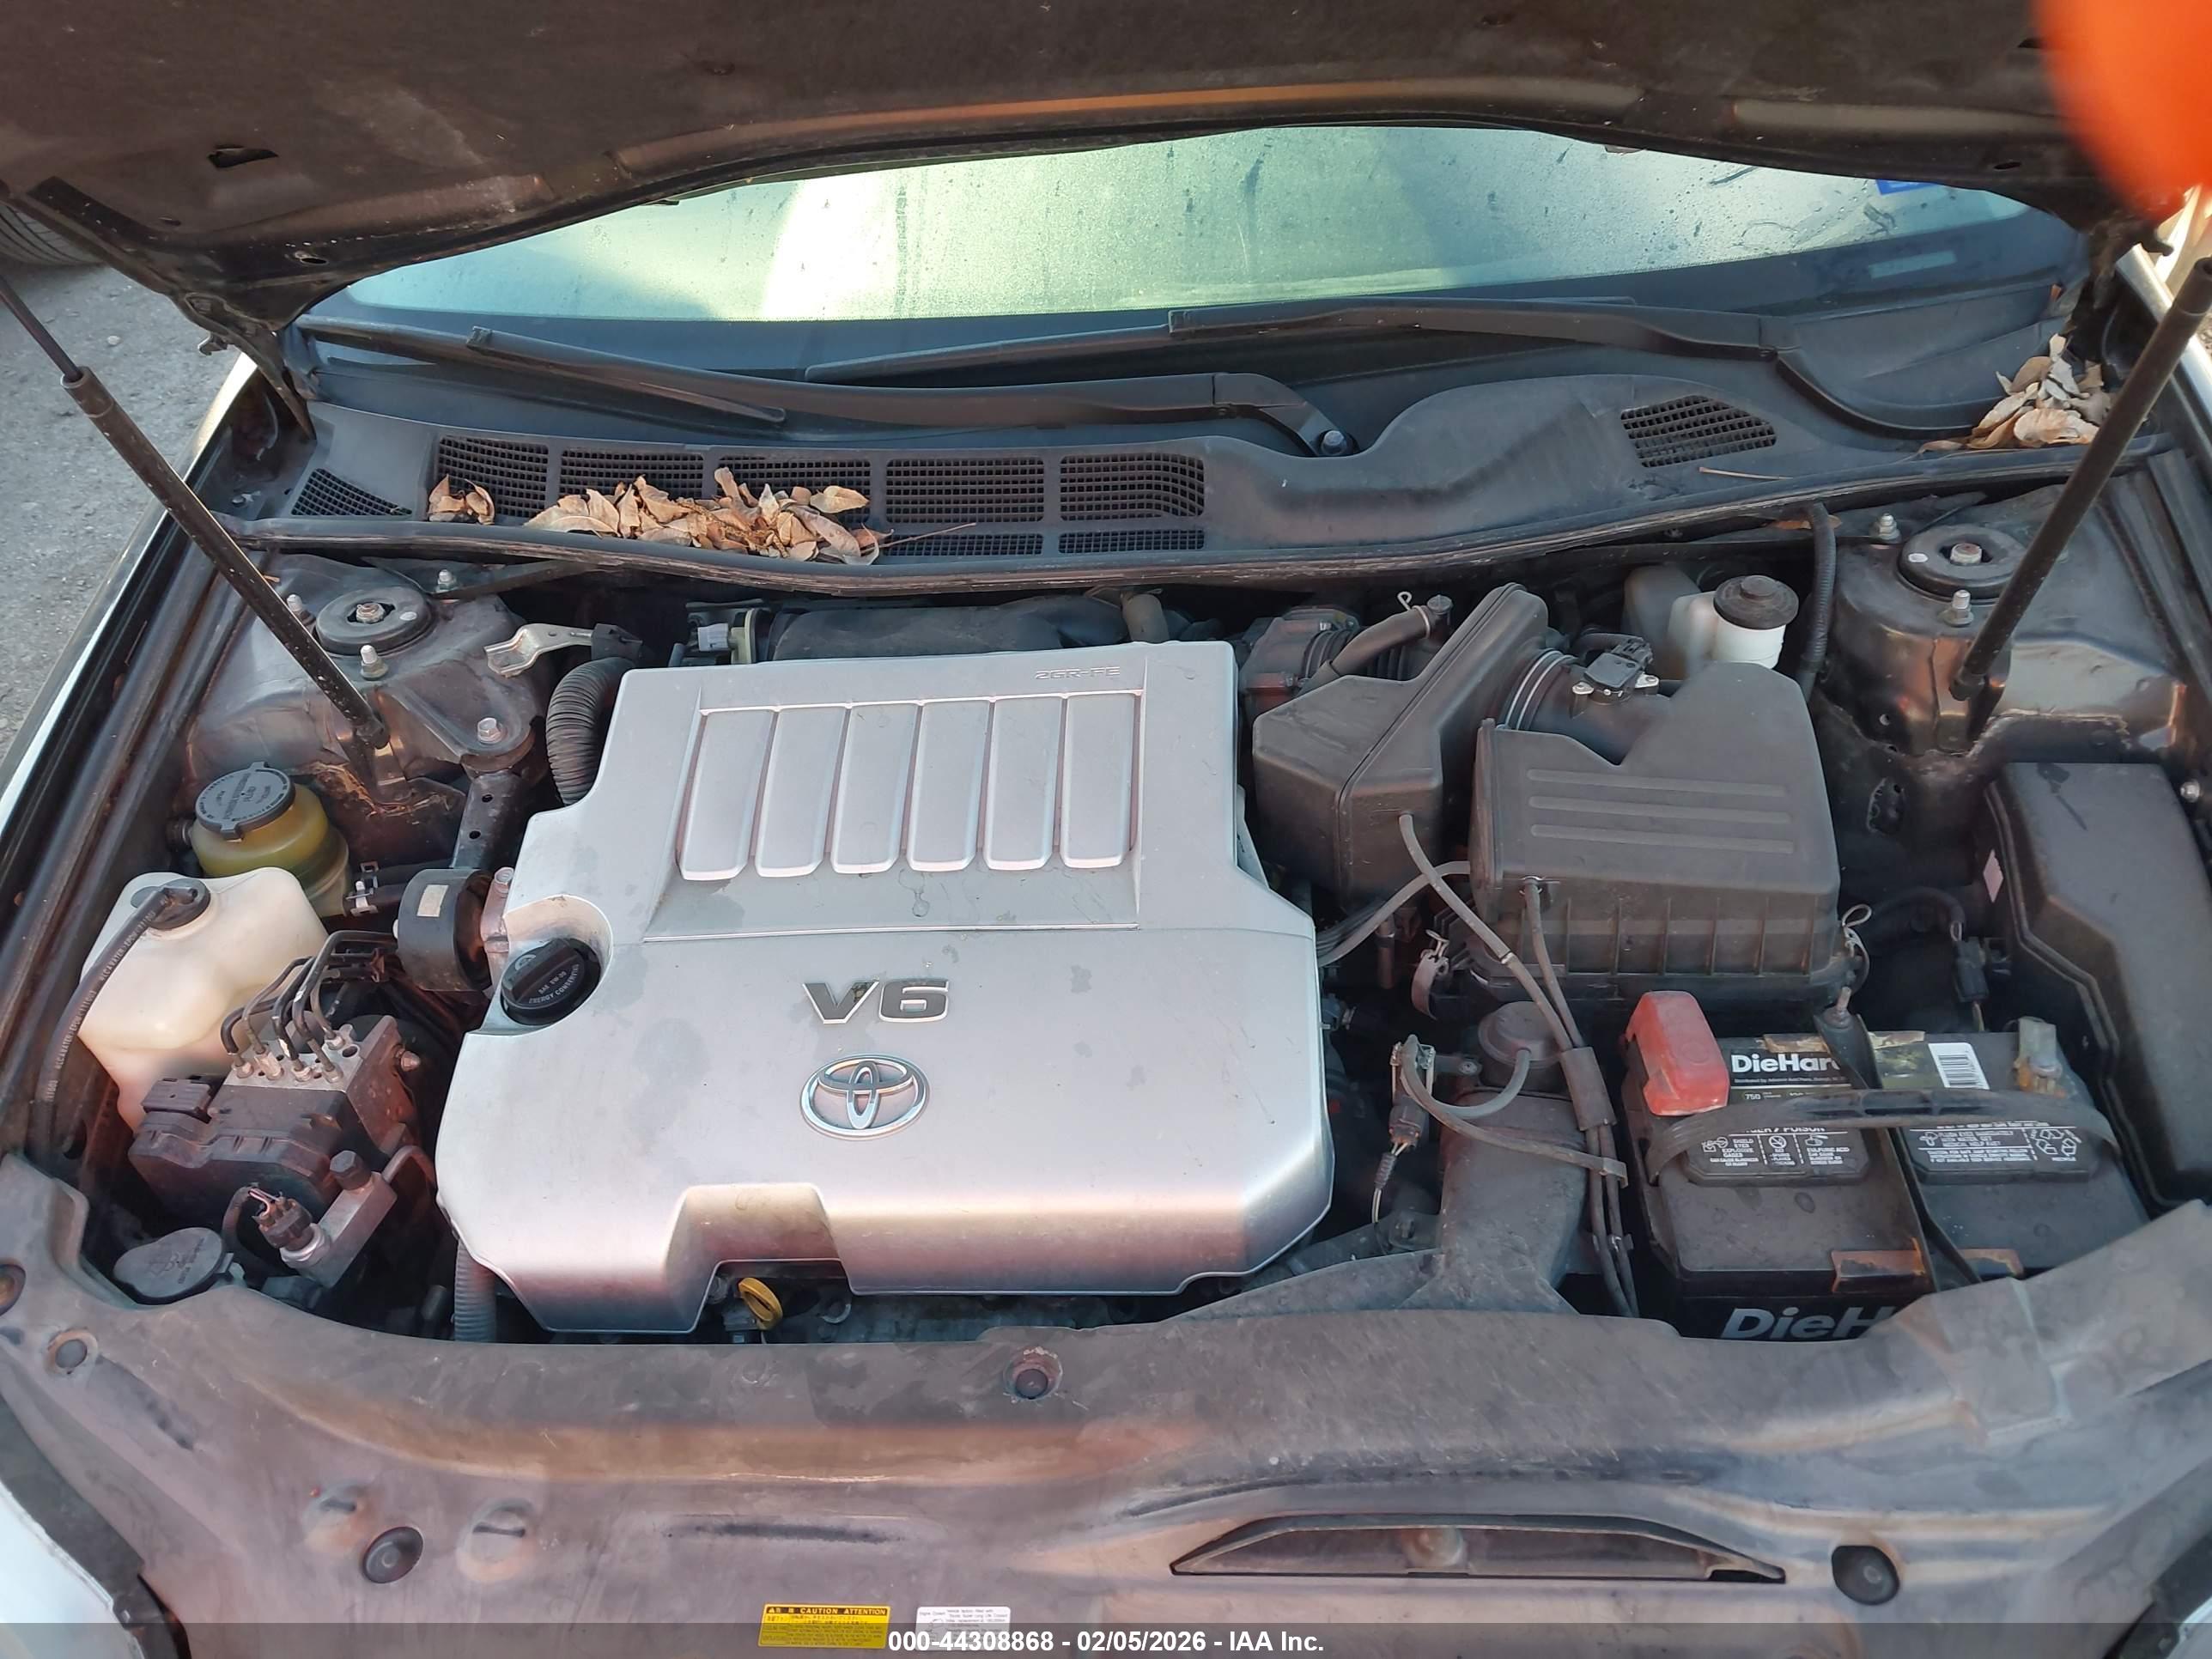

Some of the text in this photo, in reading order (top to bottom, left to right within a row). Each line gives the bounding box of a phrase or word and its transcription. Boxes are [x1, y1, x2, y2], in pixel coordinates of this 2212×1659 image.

[1034, 666, 1121, 680] 2GR-FE
[528, 963, 580, 1004] ENERGY CONSERVING
[802, 981, 950, 1024] V6
[1720, 1306, 1895, 1340] DieH
